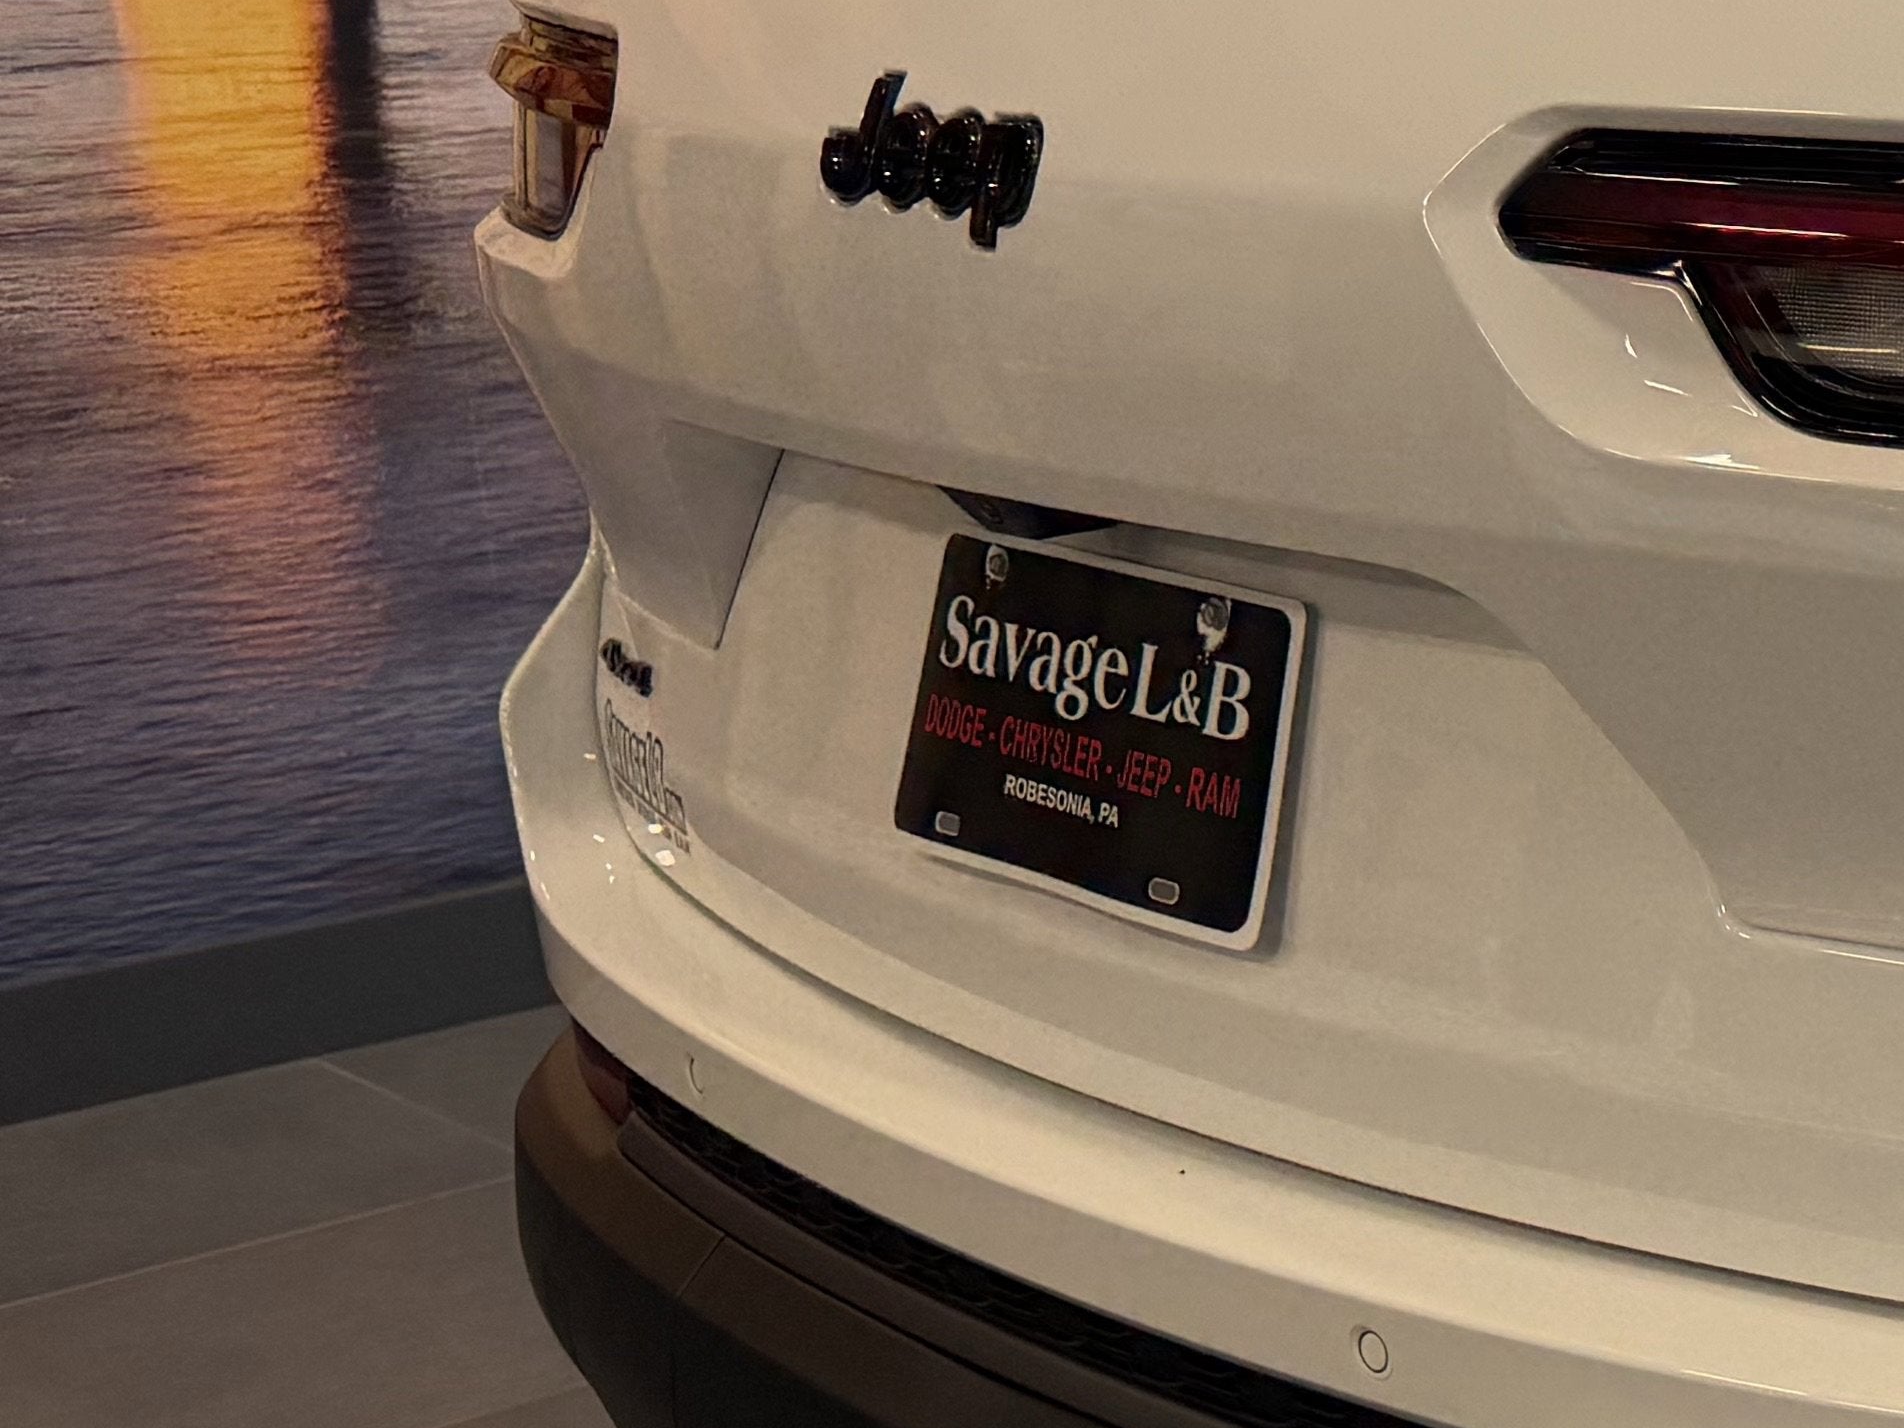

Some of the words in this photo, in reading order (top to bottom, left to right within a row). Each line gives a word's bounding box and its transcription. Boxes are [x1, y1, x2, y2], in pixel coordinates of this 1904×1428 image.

[819, 69, 1044, 251] Jeep
[924, 692, 986, 748] DODGE
[1000, 716, 1102, 781] CHRYSLER
[1117, 749, 1172, 799] JEEP
[1186, 767, 1242, 819] RAM
[1003, 773, 1095, 825] ROBESONIA,
[1098, 802, 1119, 829] PA
